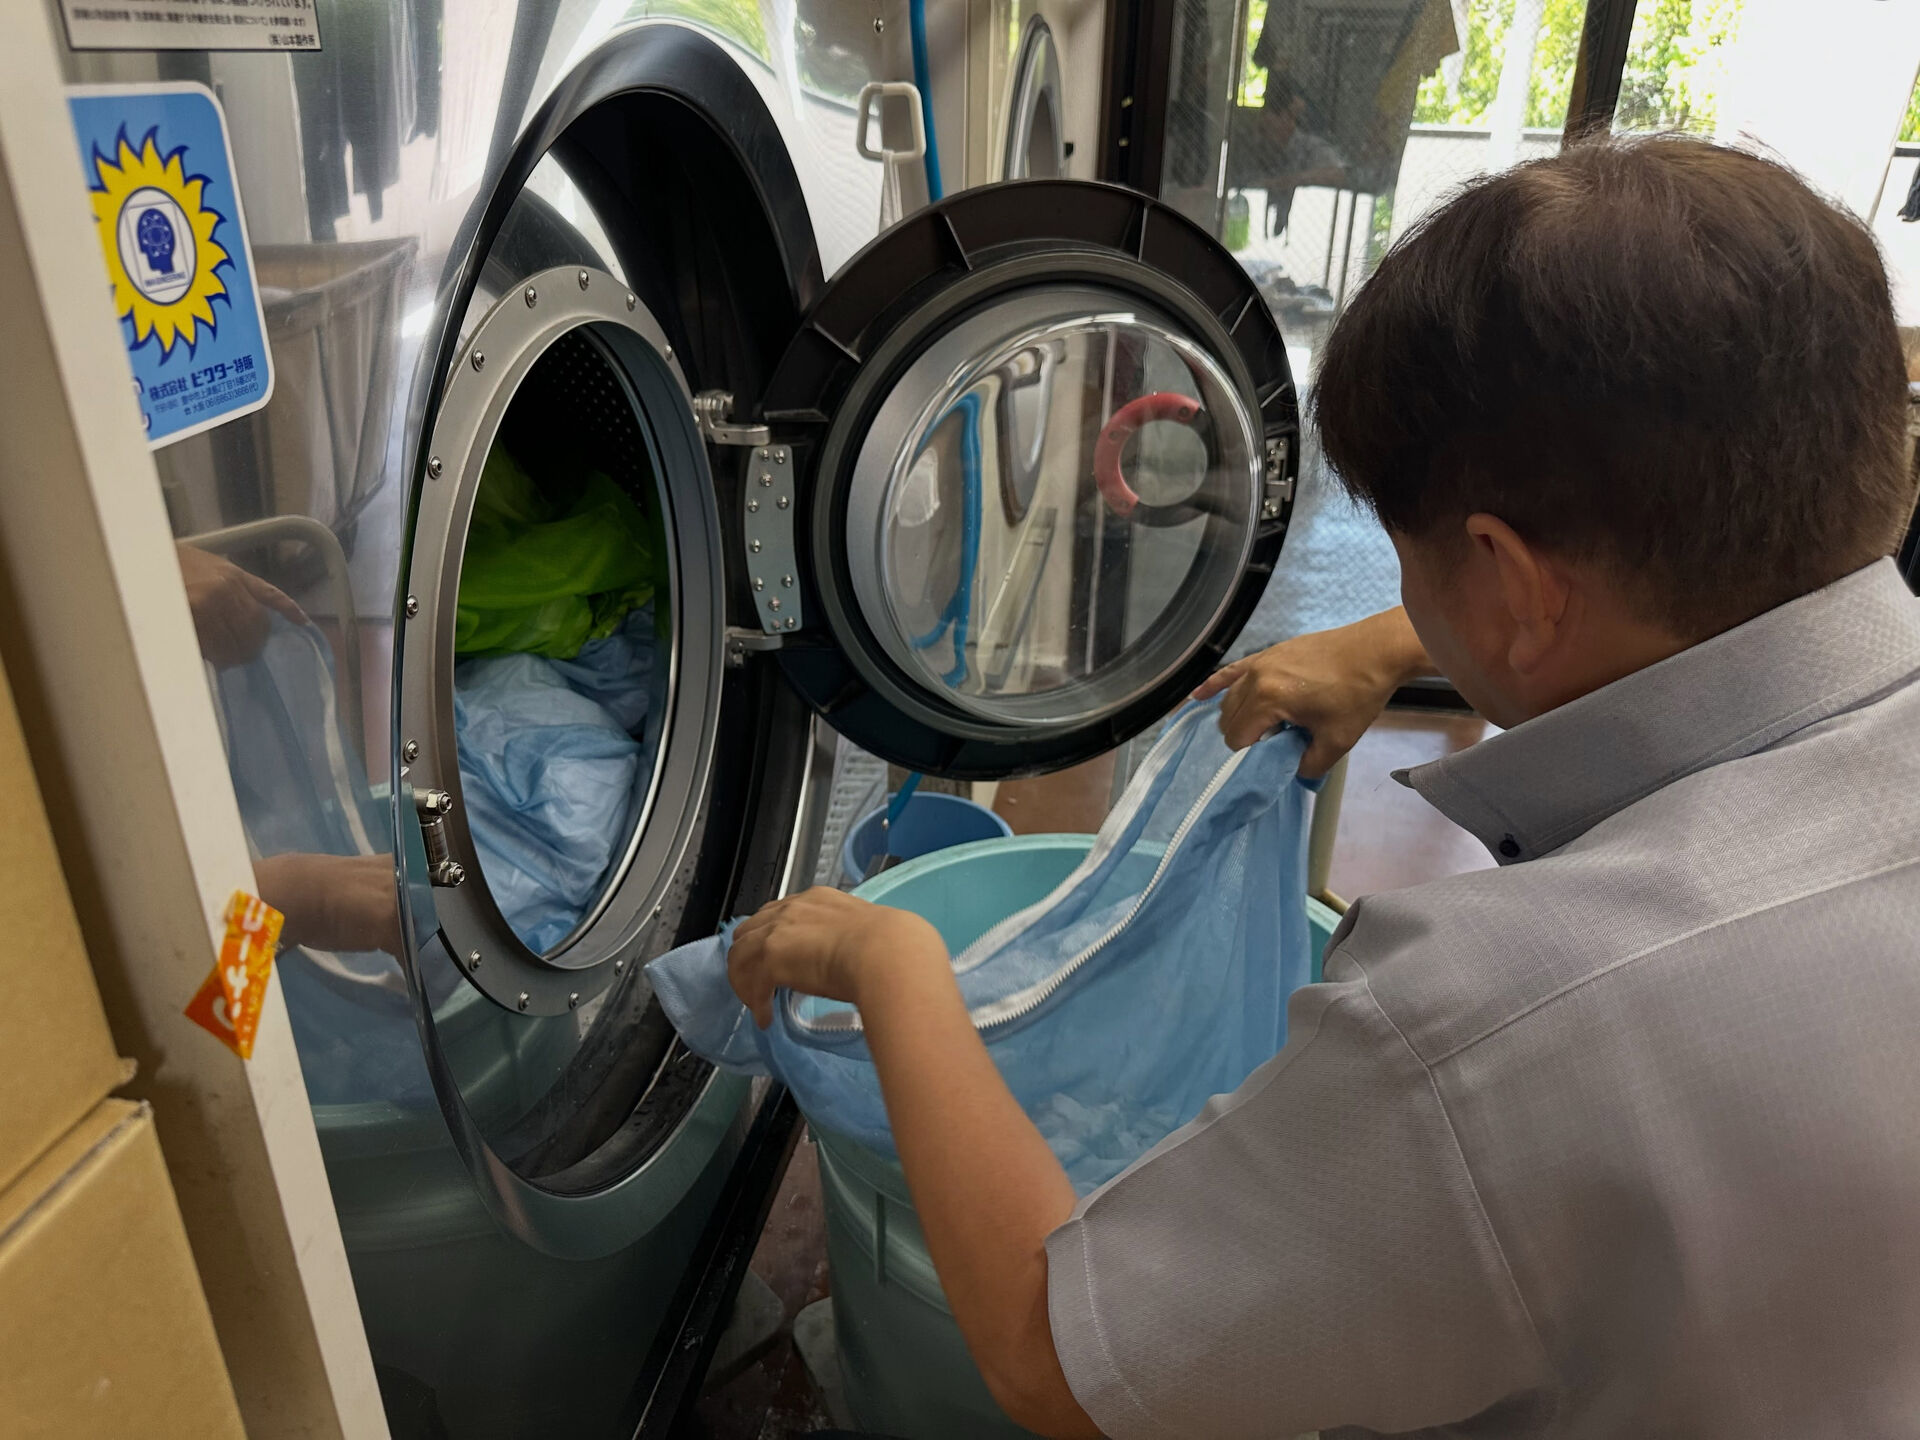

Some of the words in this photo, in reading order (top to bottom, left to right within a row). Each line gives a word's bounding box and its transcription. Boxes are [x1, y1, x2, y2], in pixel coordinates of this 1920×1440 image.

[149, 376, 188, 401] 株式会社
[191, 354, 254, 388] ビクター特販
